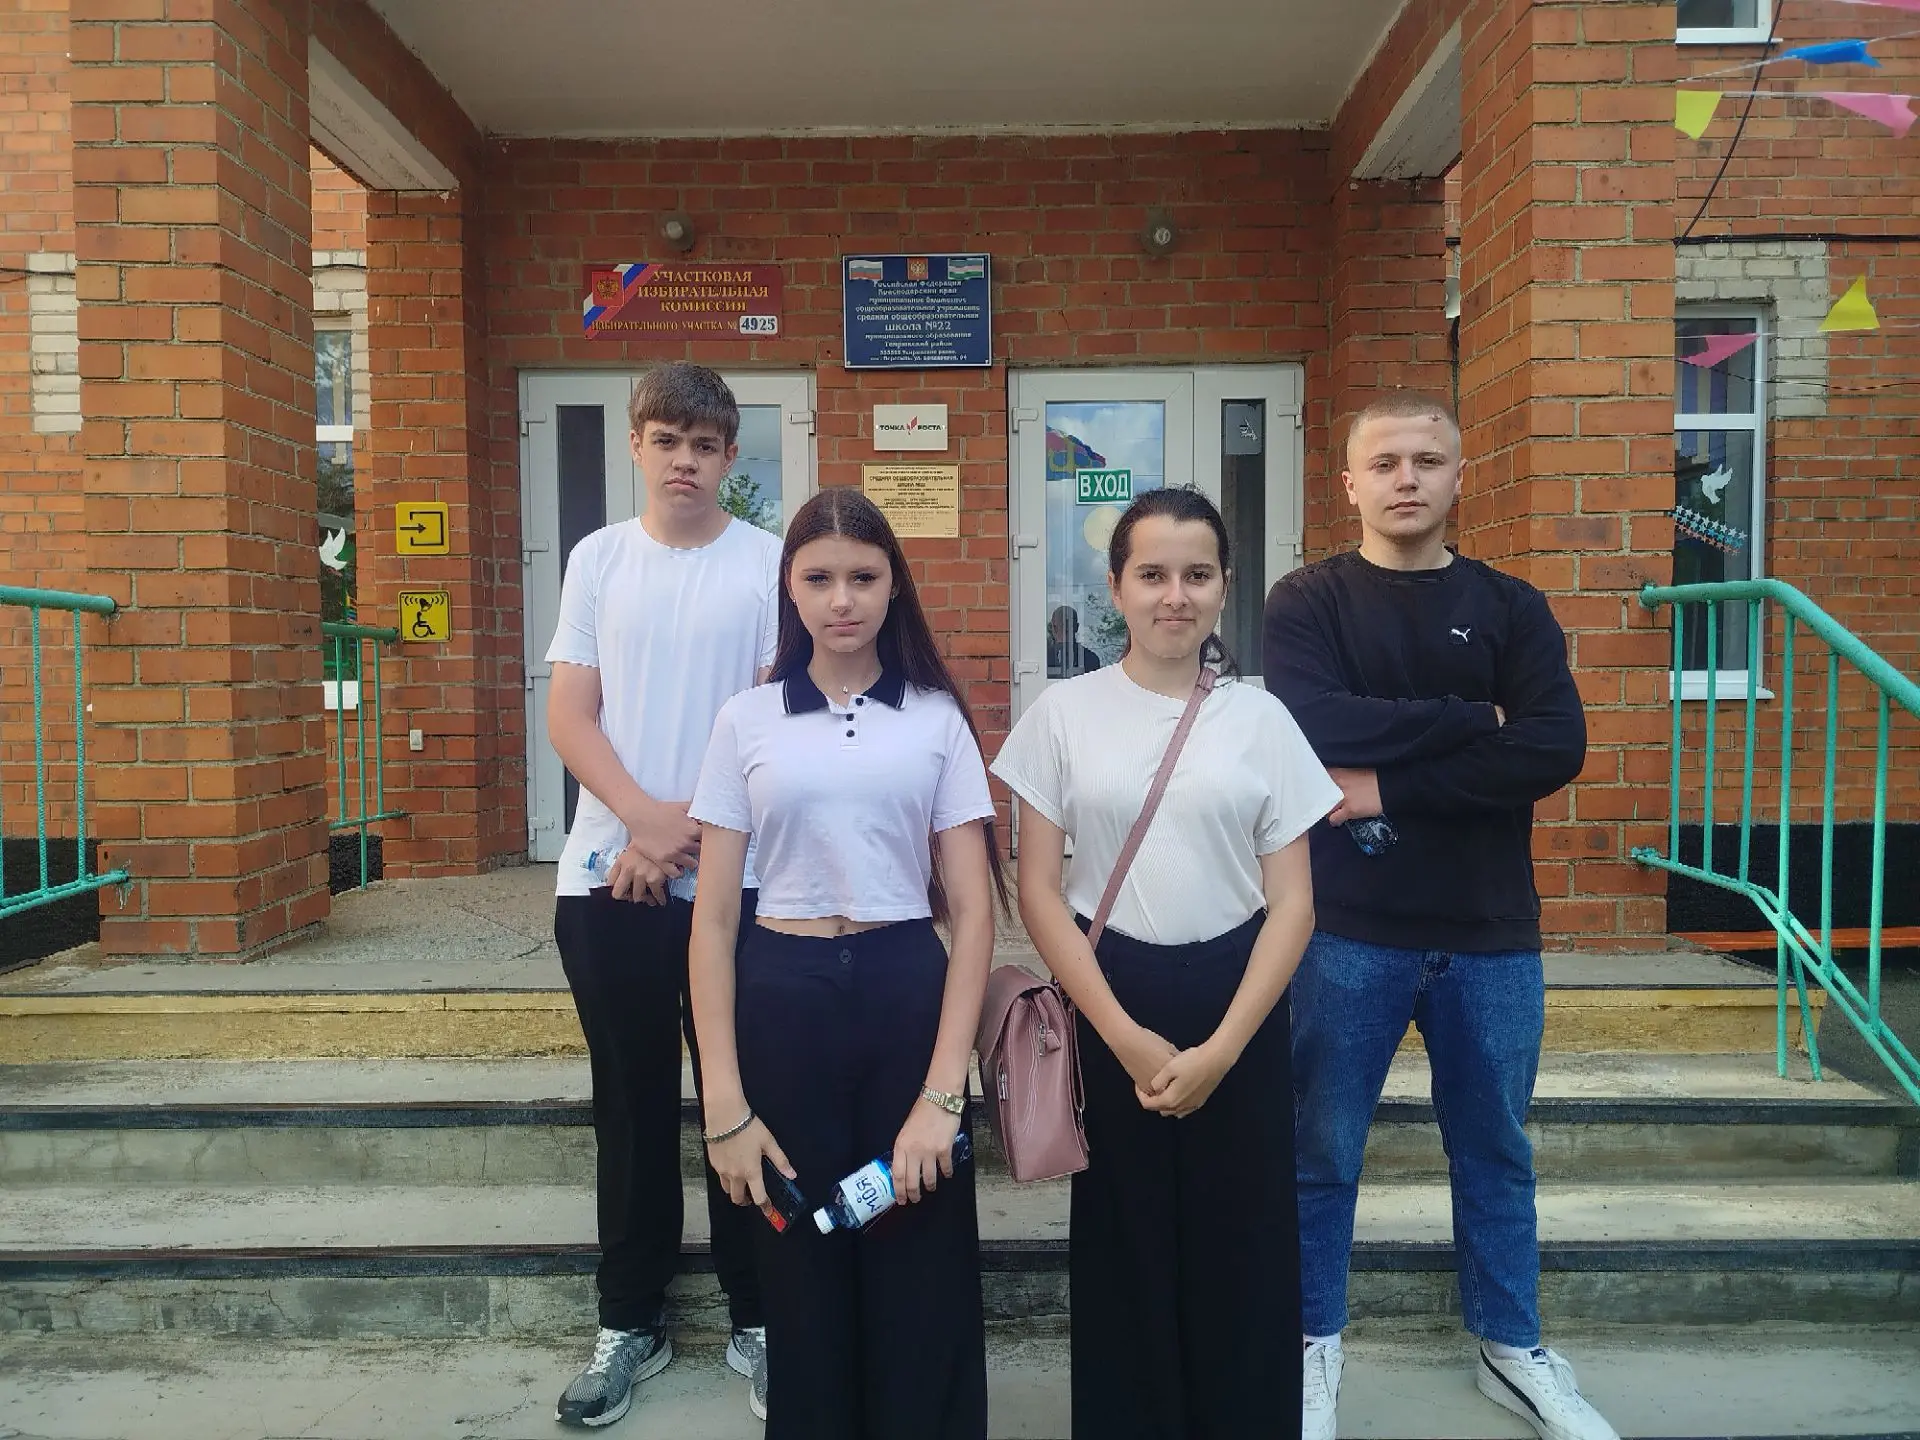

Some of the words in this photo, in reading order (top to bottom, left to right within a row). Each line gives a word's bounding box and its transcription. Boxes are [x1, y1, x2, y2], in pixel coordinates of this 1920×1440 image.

[653, 271, 753, 283] УЧАСТКОВАЯ
[637, 286, 769, 298] ИЗБИРАТЕЛЬНАЯ
[660, 301, 748, 313] КОМИССИЯ
[591, 321, 679, 331] ИЗБИРАТЕЛЬНОГО
[681, 320, 723, 331] УЧАСТКА
[741, 317, 776, 332] 4925
[885, 323, 922, 331] школа
[925, 322, 951, 331] №22
[1080, 473, 1129, 499] ВХОД
